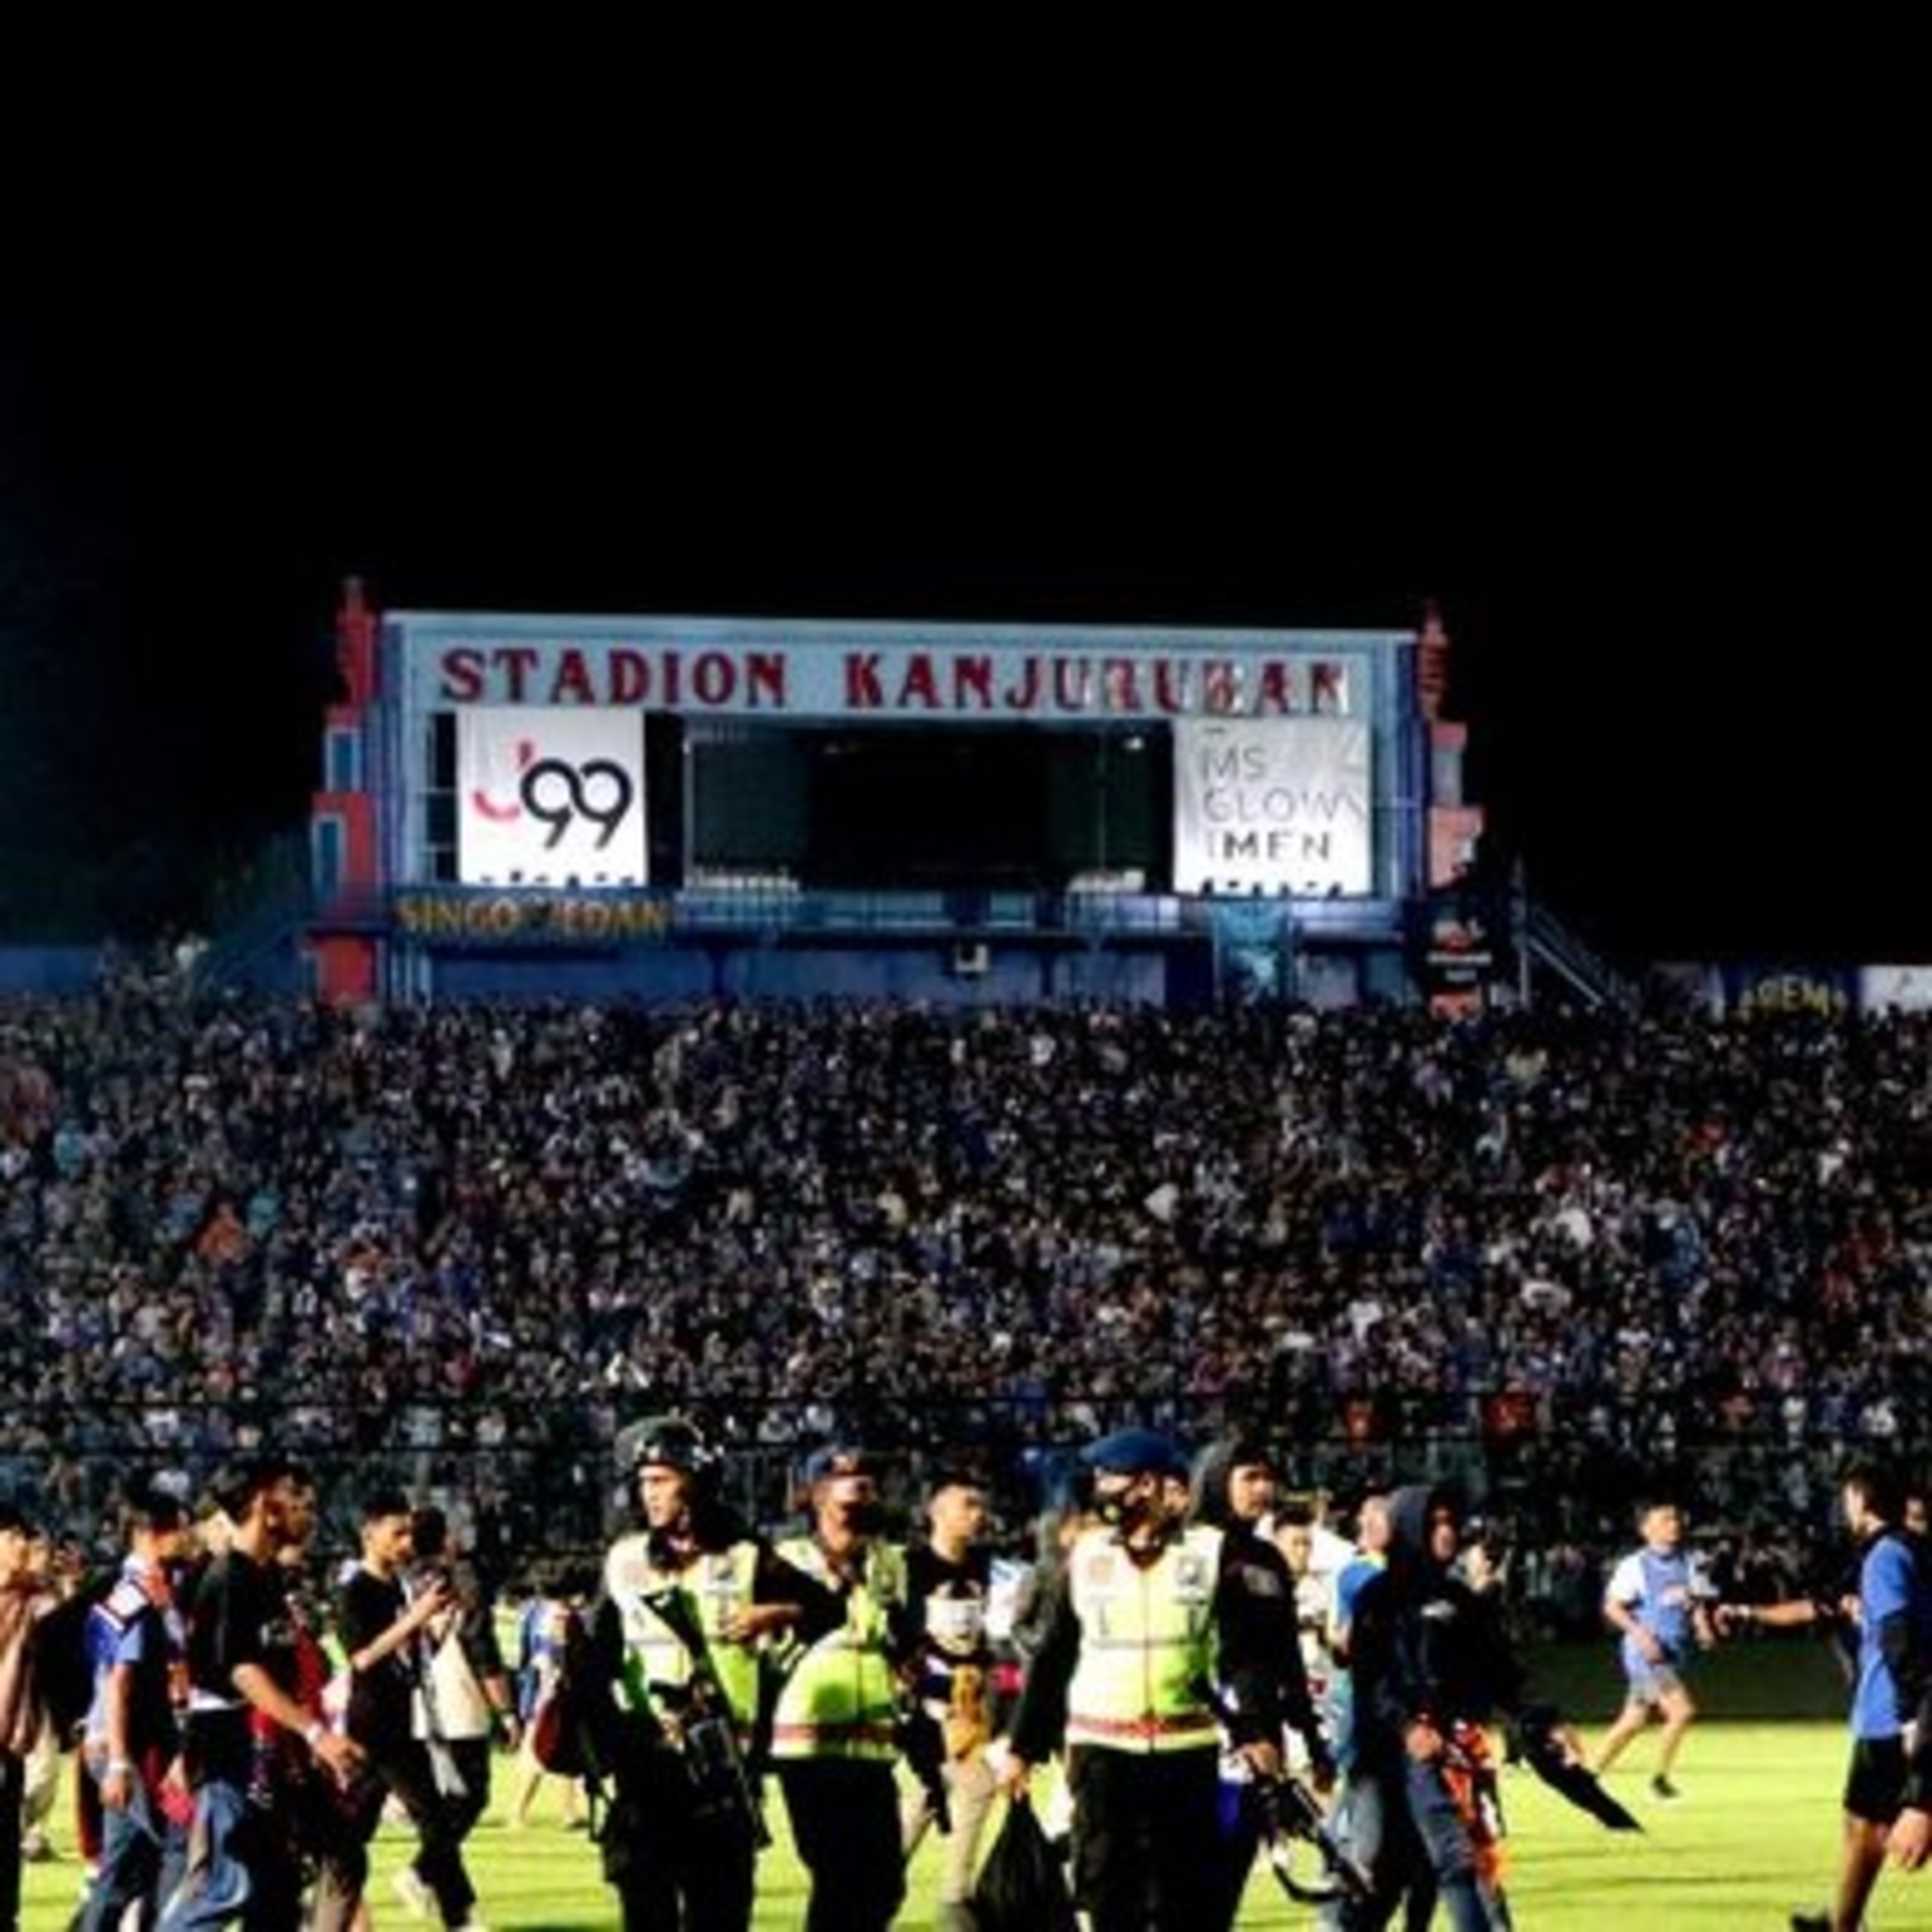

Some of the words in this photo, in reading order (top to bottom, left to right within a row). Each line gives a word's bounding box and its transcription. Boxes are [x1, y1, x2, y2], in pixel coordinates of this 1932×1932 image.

[439, 648, 786, 706] STADION
[1202, 744, 1266, 781] MS
[1202, 787, 1346, 824] GLOW
[1222, 829, 1329, 862] MEN
